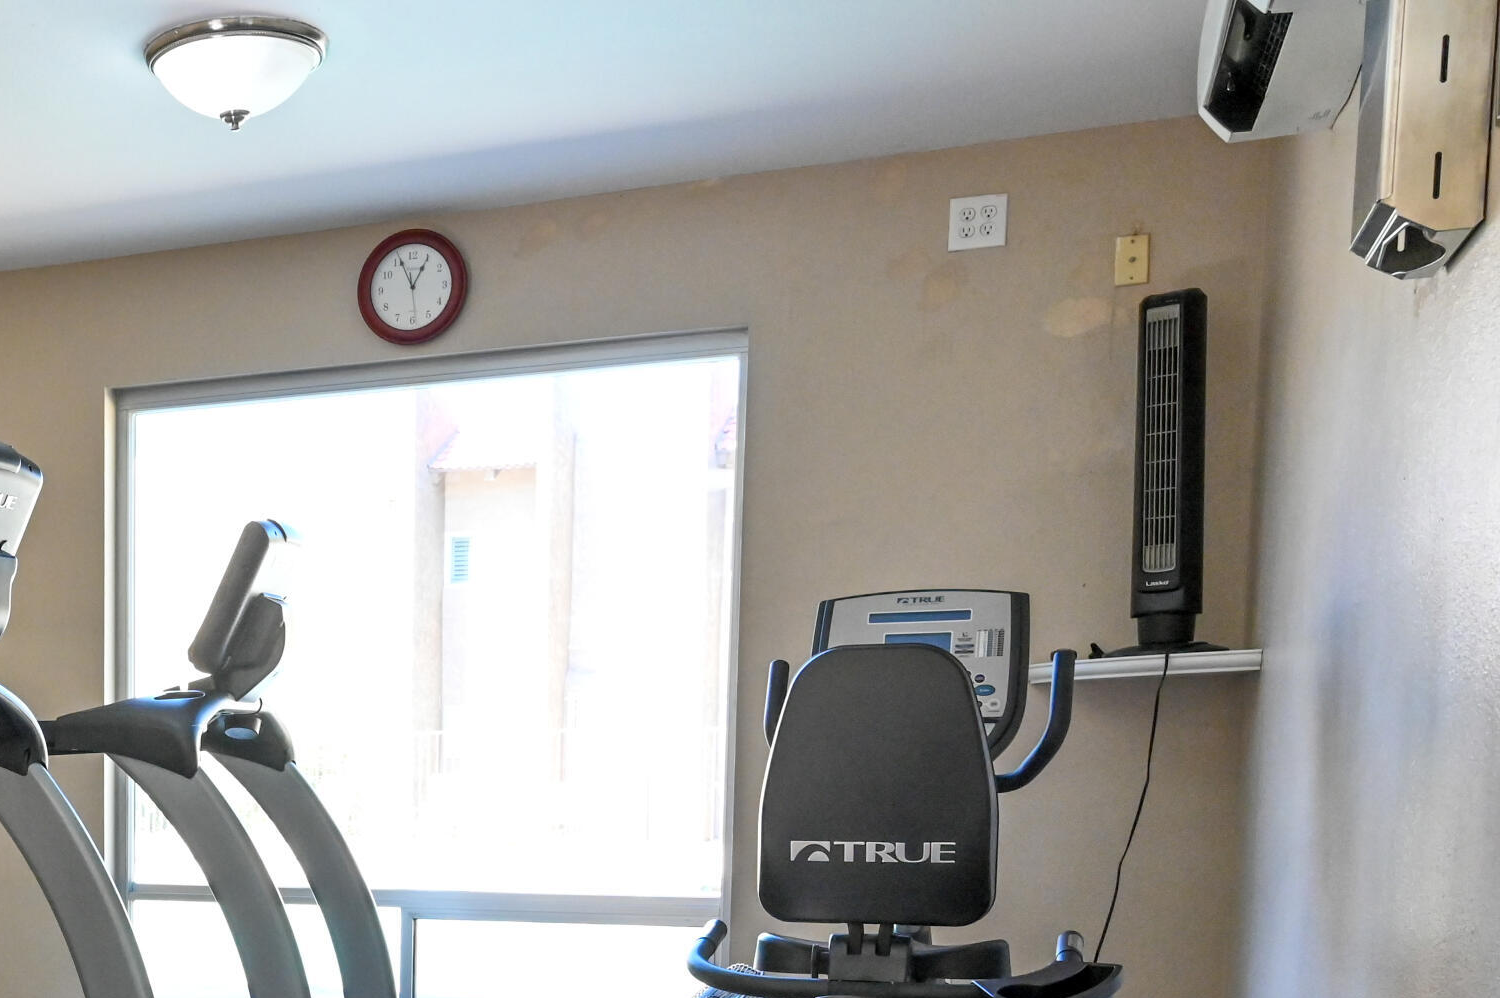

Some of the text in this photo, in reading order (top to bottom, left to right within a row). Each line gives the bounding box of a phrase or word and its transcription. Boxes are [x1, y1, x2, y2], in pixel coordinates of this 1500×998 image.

[408, 251, 418, 260] 12
[383, 271, 393, 280] 10
[442, 280, 448, 289] 3
[378, 287, 384, 296] 9
[383, 303, 389, 311] 8
[395, 313, 401, 322] 7
[425, 310, 432, 318] 5
[911, 596, 945, 604] TRUE
[833, 841, 957, 863] TRUE
